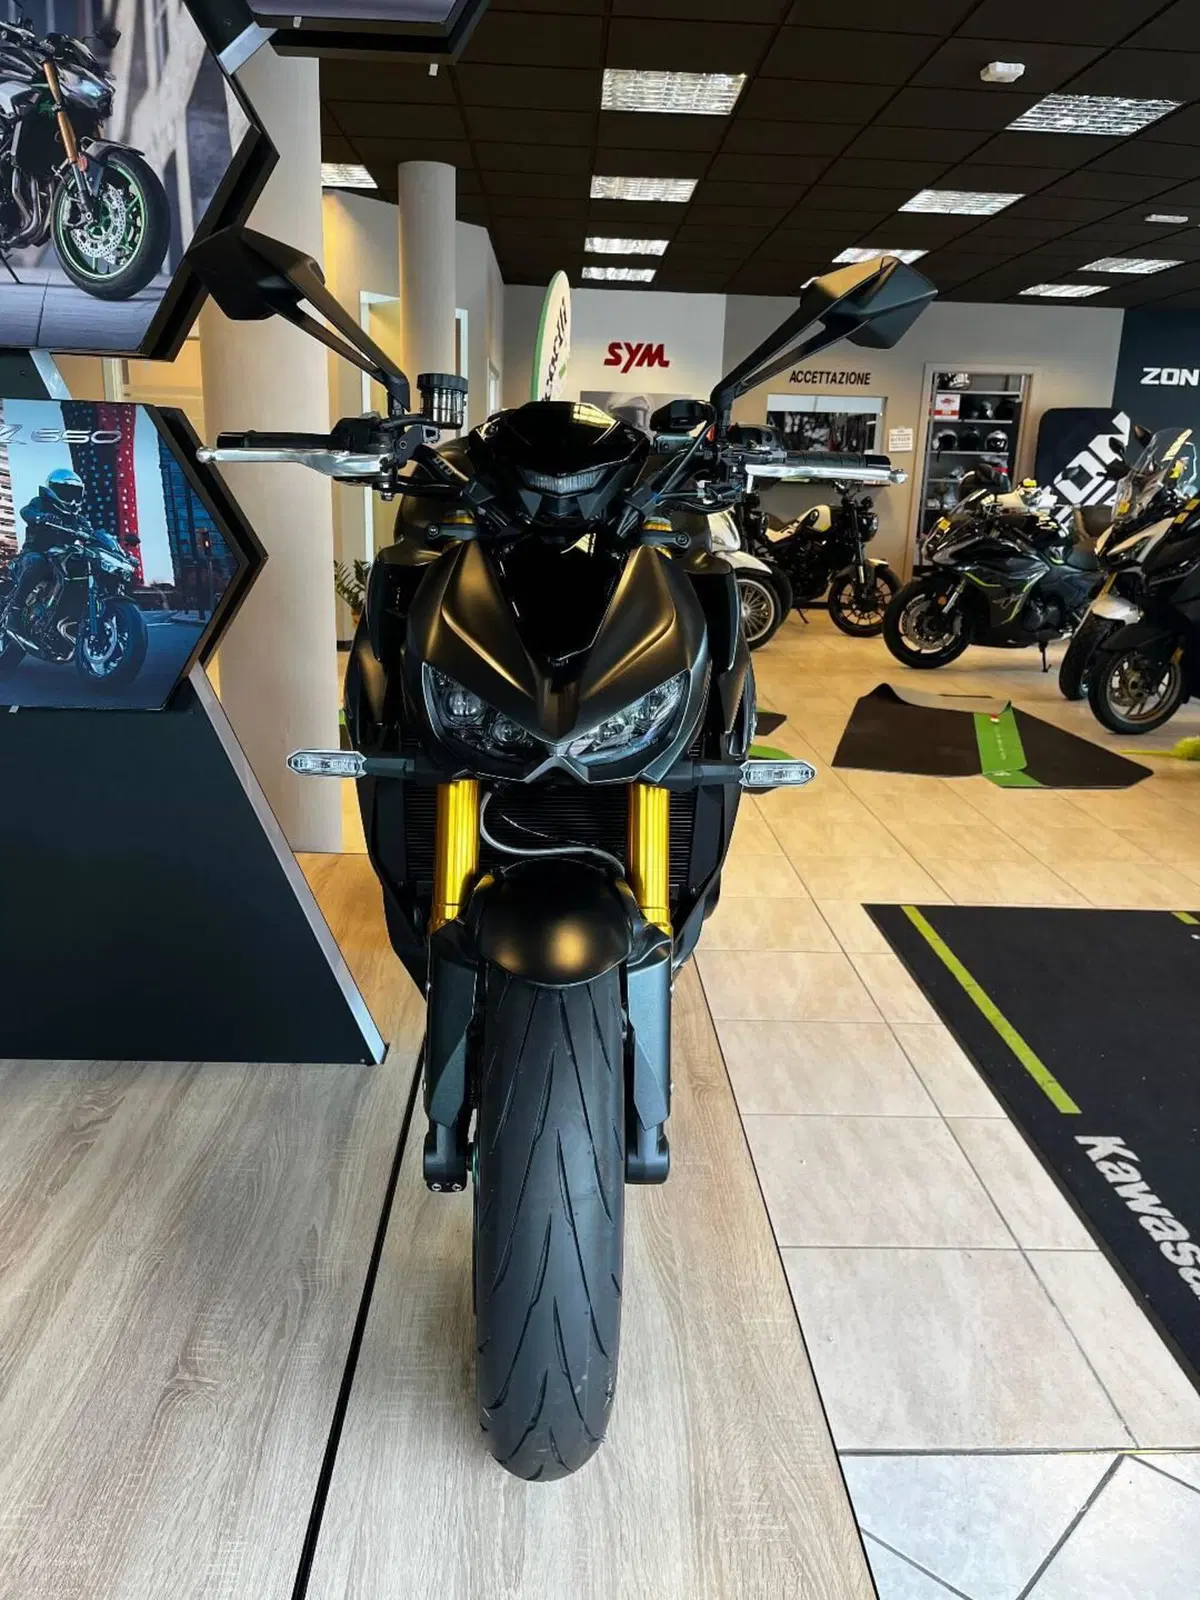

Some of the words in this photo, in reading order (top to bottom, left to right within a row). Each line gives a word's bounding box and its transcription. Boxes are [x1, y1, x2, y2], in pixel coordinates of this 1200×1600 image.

[603, 342, 670, 374] SYM
[789, 370, 872, 386] ACCETTAZIONE
[1140, 367, 1200, 387] ZON
[31, 428, 122, 444] 650
